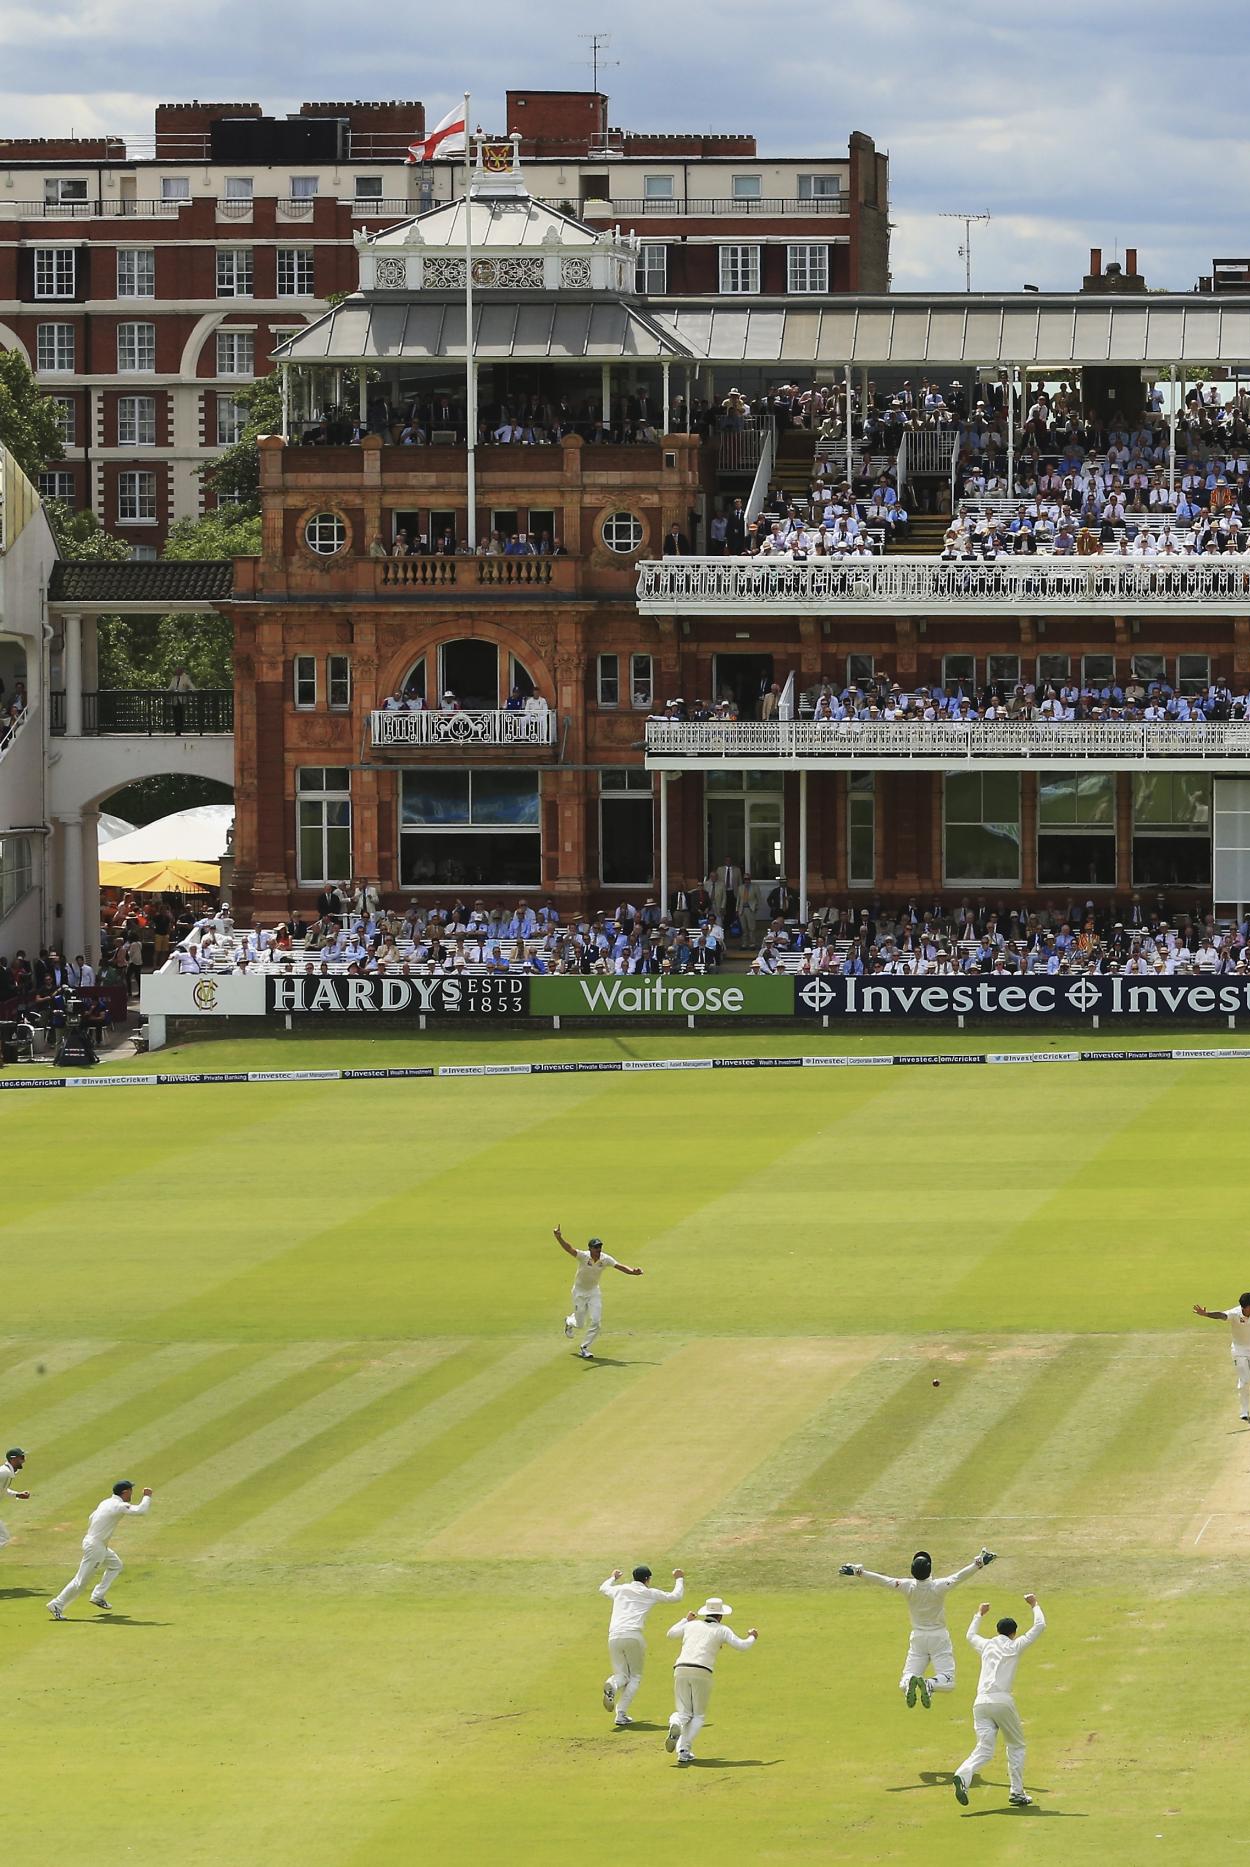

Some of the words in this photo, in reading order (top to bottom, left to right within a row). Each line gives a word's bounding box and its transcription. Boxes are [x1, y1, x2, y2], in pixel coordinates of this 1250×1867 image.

[468, 979, 523, 993] ESTD
[273, 978, 463, 1012] HARDYS
[580, 976, 744, 1012] Waitrose
[845, 977, 1055, 1012] Investec
[468, 998, 522, 1012] 1853
[1150, 1051, 1170, 1059] Banking
[226, 1074, 247, 1082] Banking
[258, 1072, 291, 1080] Investec
